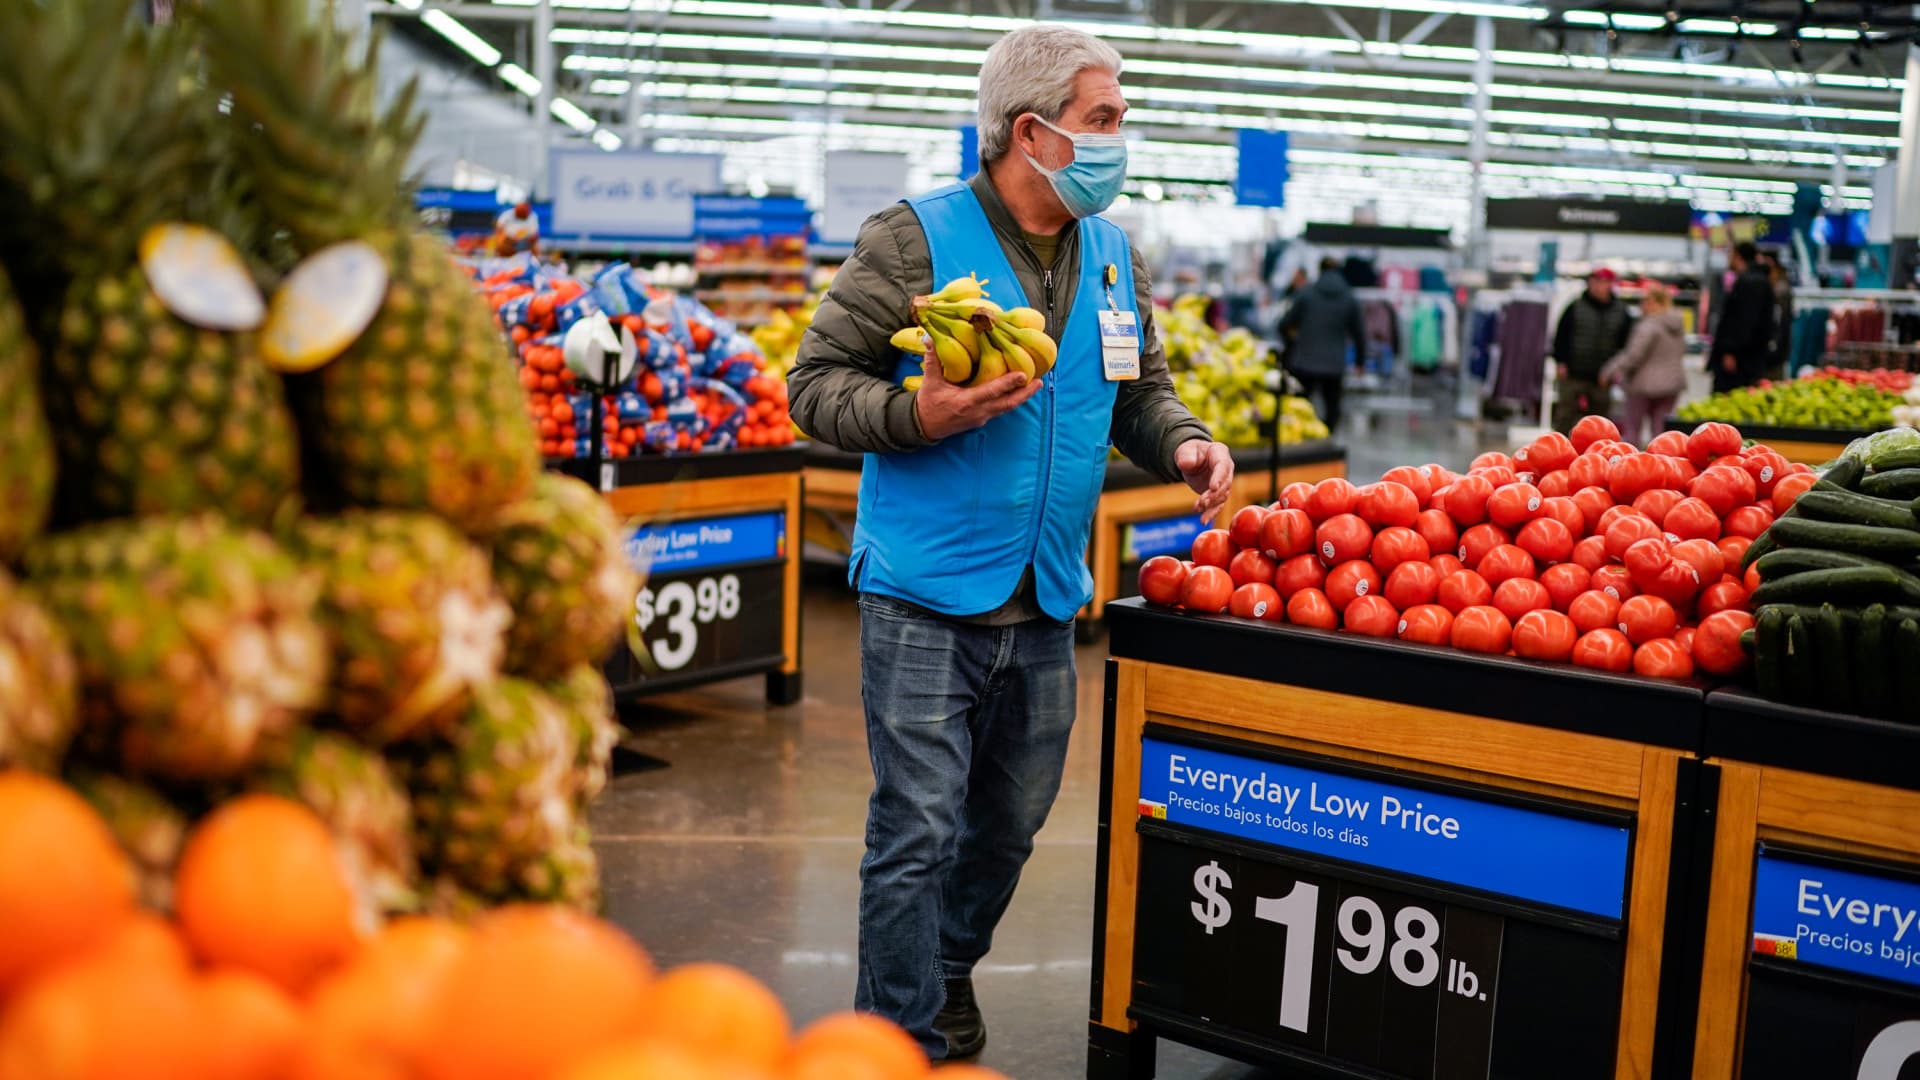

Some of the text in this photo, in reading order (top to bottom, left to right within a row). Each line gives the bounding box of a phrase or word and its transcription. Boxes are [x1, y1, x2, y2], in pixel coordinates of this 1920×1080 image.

[1168, 791, 1220, 816] Precios
[1224, 802, 1262, 825] bajos
[1265, 812, 1309, 835] todos
[1313, 820, 1334, 840] los
[1338, 826, 1369, 848] días
[1169, 754, 1460, 839] Everyday Low Price
[1796, 923, 1874, 955] Precios
[1797, 879, 1920, 942] Every
[1447, 958, 1488, 1002] lb.
